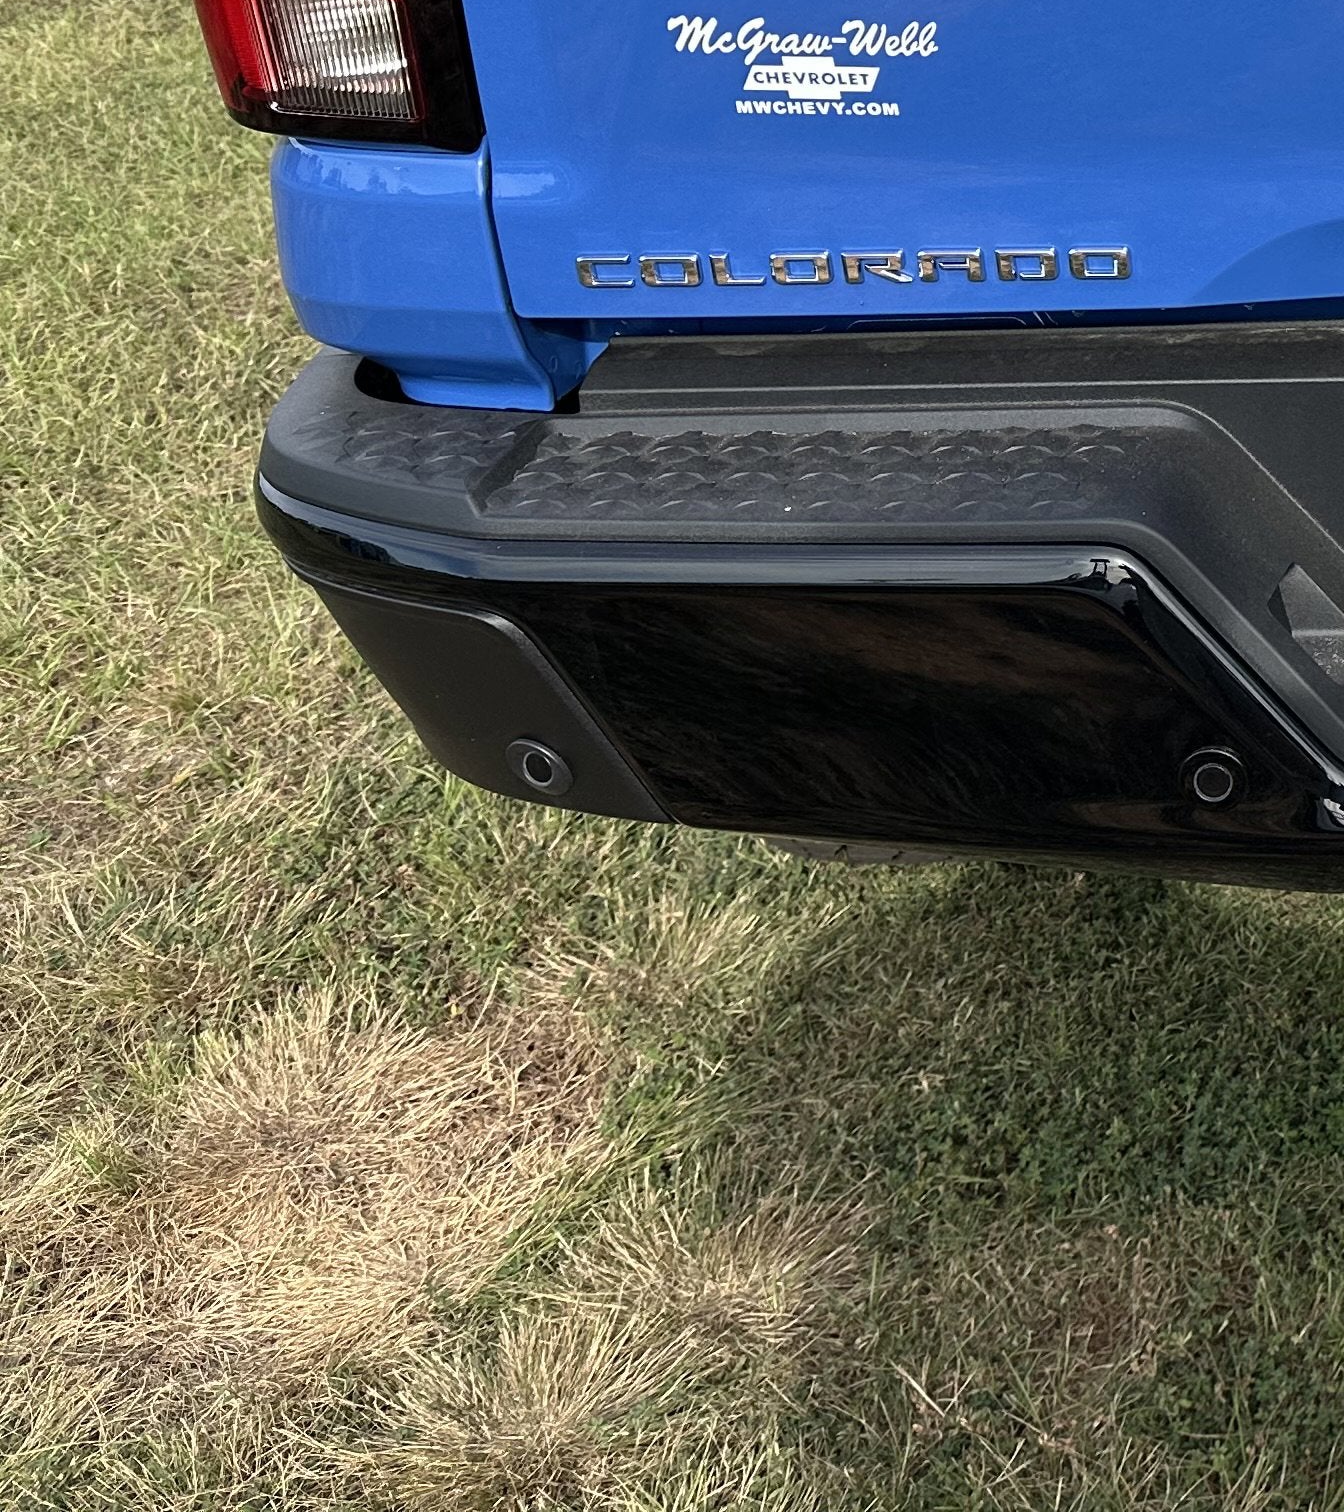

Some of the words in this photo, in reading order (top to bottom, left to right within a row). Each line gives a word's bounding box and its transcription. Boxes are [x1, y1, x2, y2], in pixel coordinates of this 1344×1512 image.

[667, 15, 939, 65] McGraw-Webb
[752, 71, 870, 86] CHEVROLET
[735, 100, 900, 116] MWCHEVY.COM
[575, 246, 1133, 288] COLORADO
